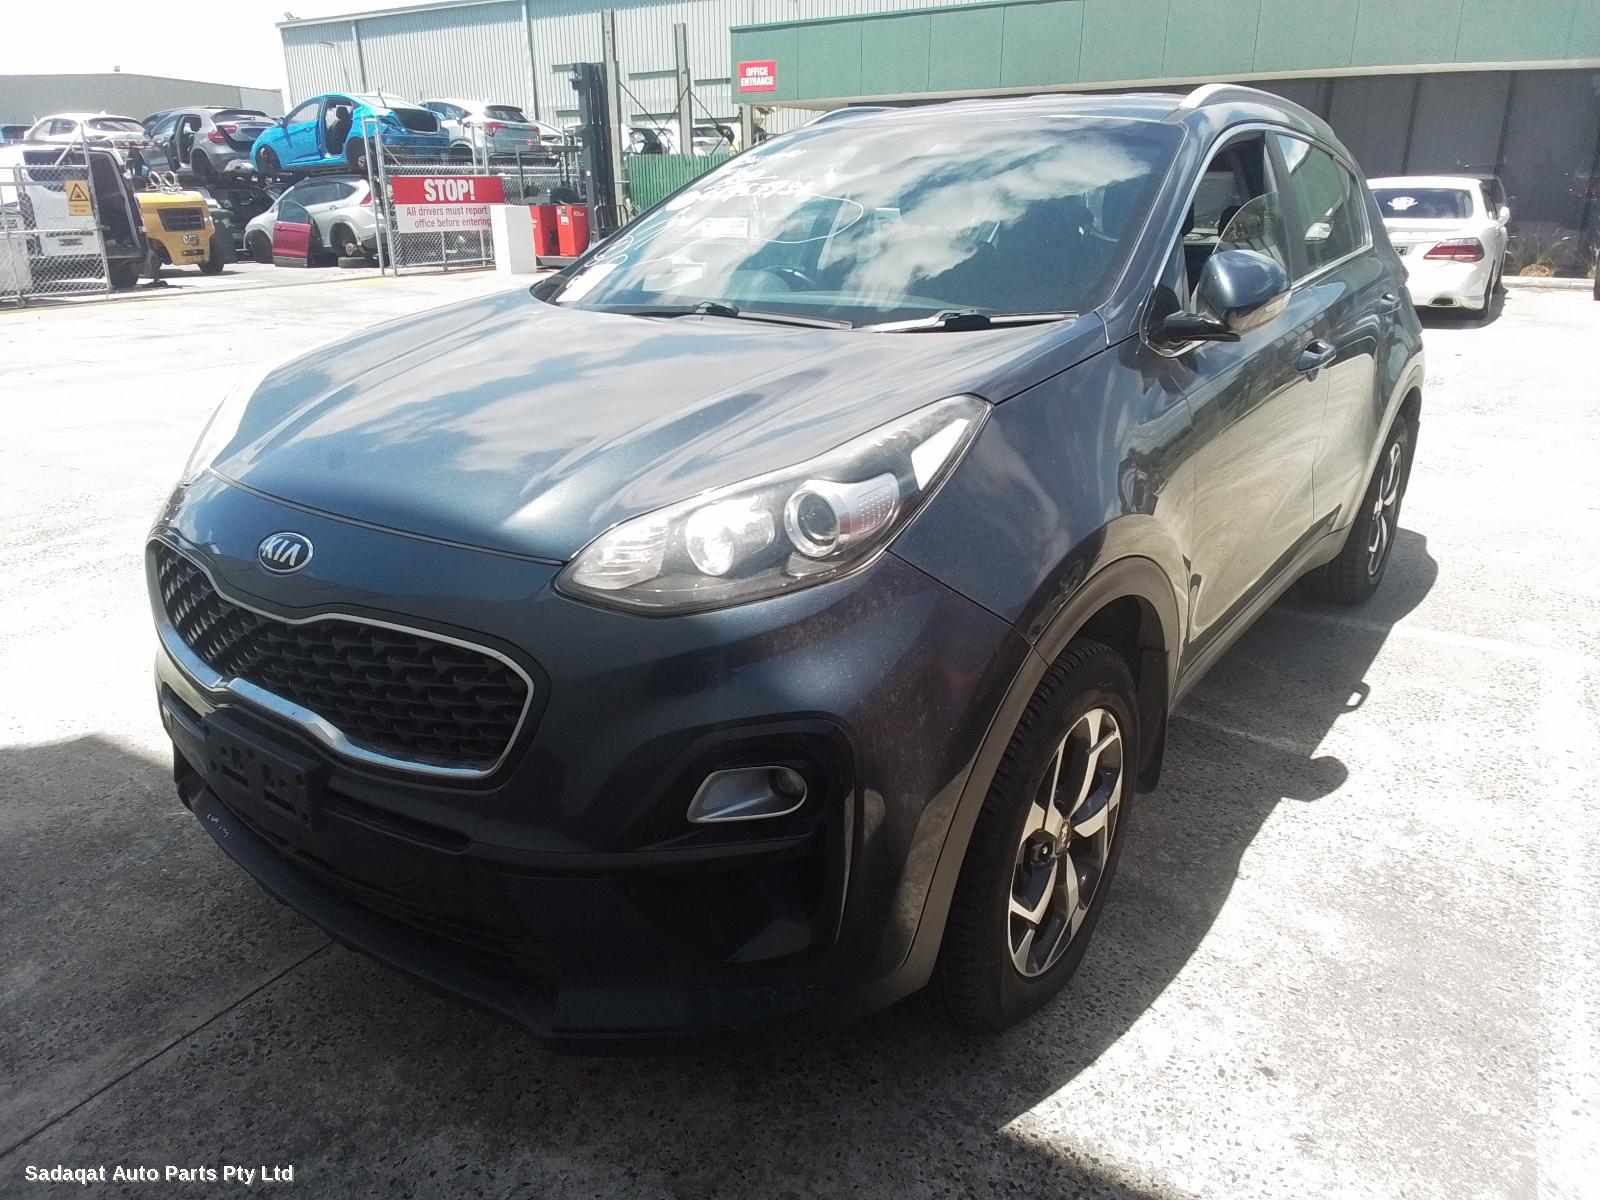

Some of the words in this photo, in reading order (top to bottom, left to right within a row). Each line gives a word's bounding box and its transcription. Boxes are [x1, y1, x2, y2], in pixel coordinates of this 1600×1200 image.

[746, 66, 768, 76] OFFICE
[741, 76, 774, 86] ENTRANCE
[423, 179, 475, 201] STOP!
[406, 206, 416, 217] All
[418, 206, 444, 216] drivers
[446, 206, 464, 216] must
[465, 205, 489, 217] report
[414, 218, 435, 229] office
[437, 218, 460, 228] before
[462, 217, 491, 228] entering
[262, 536, 302, 567] KIA
